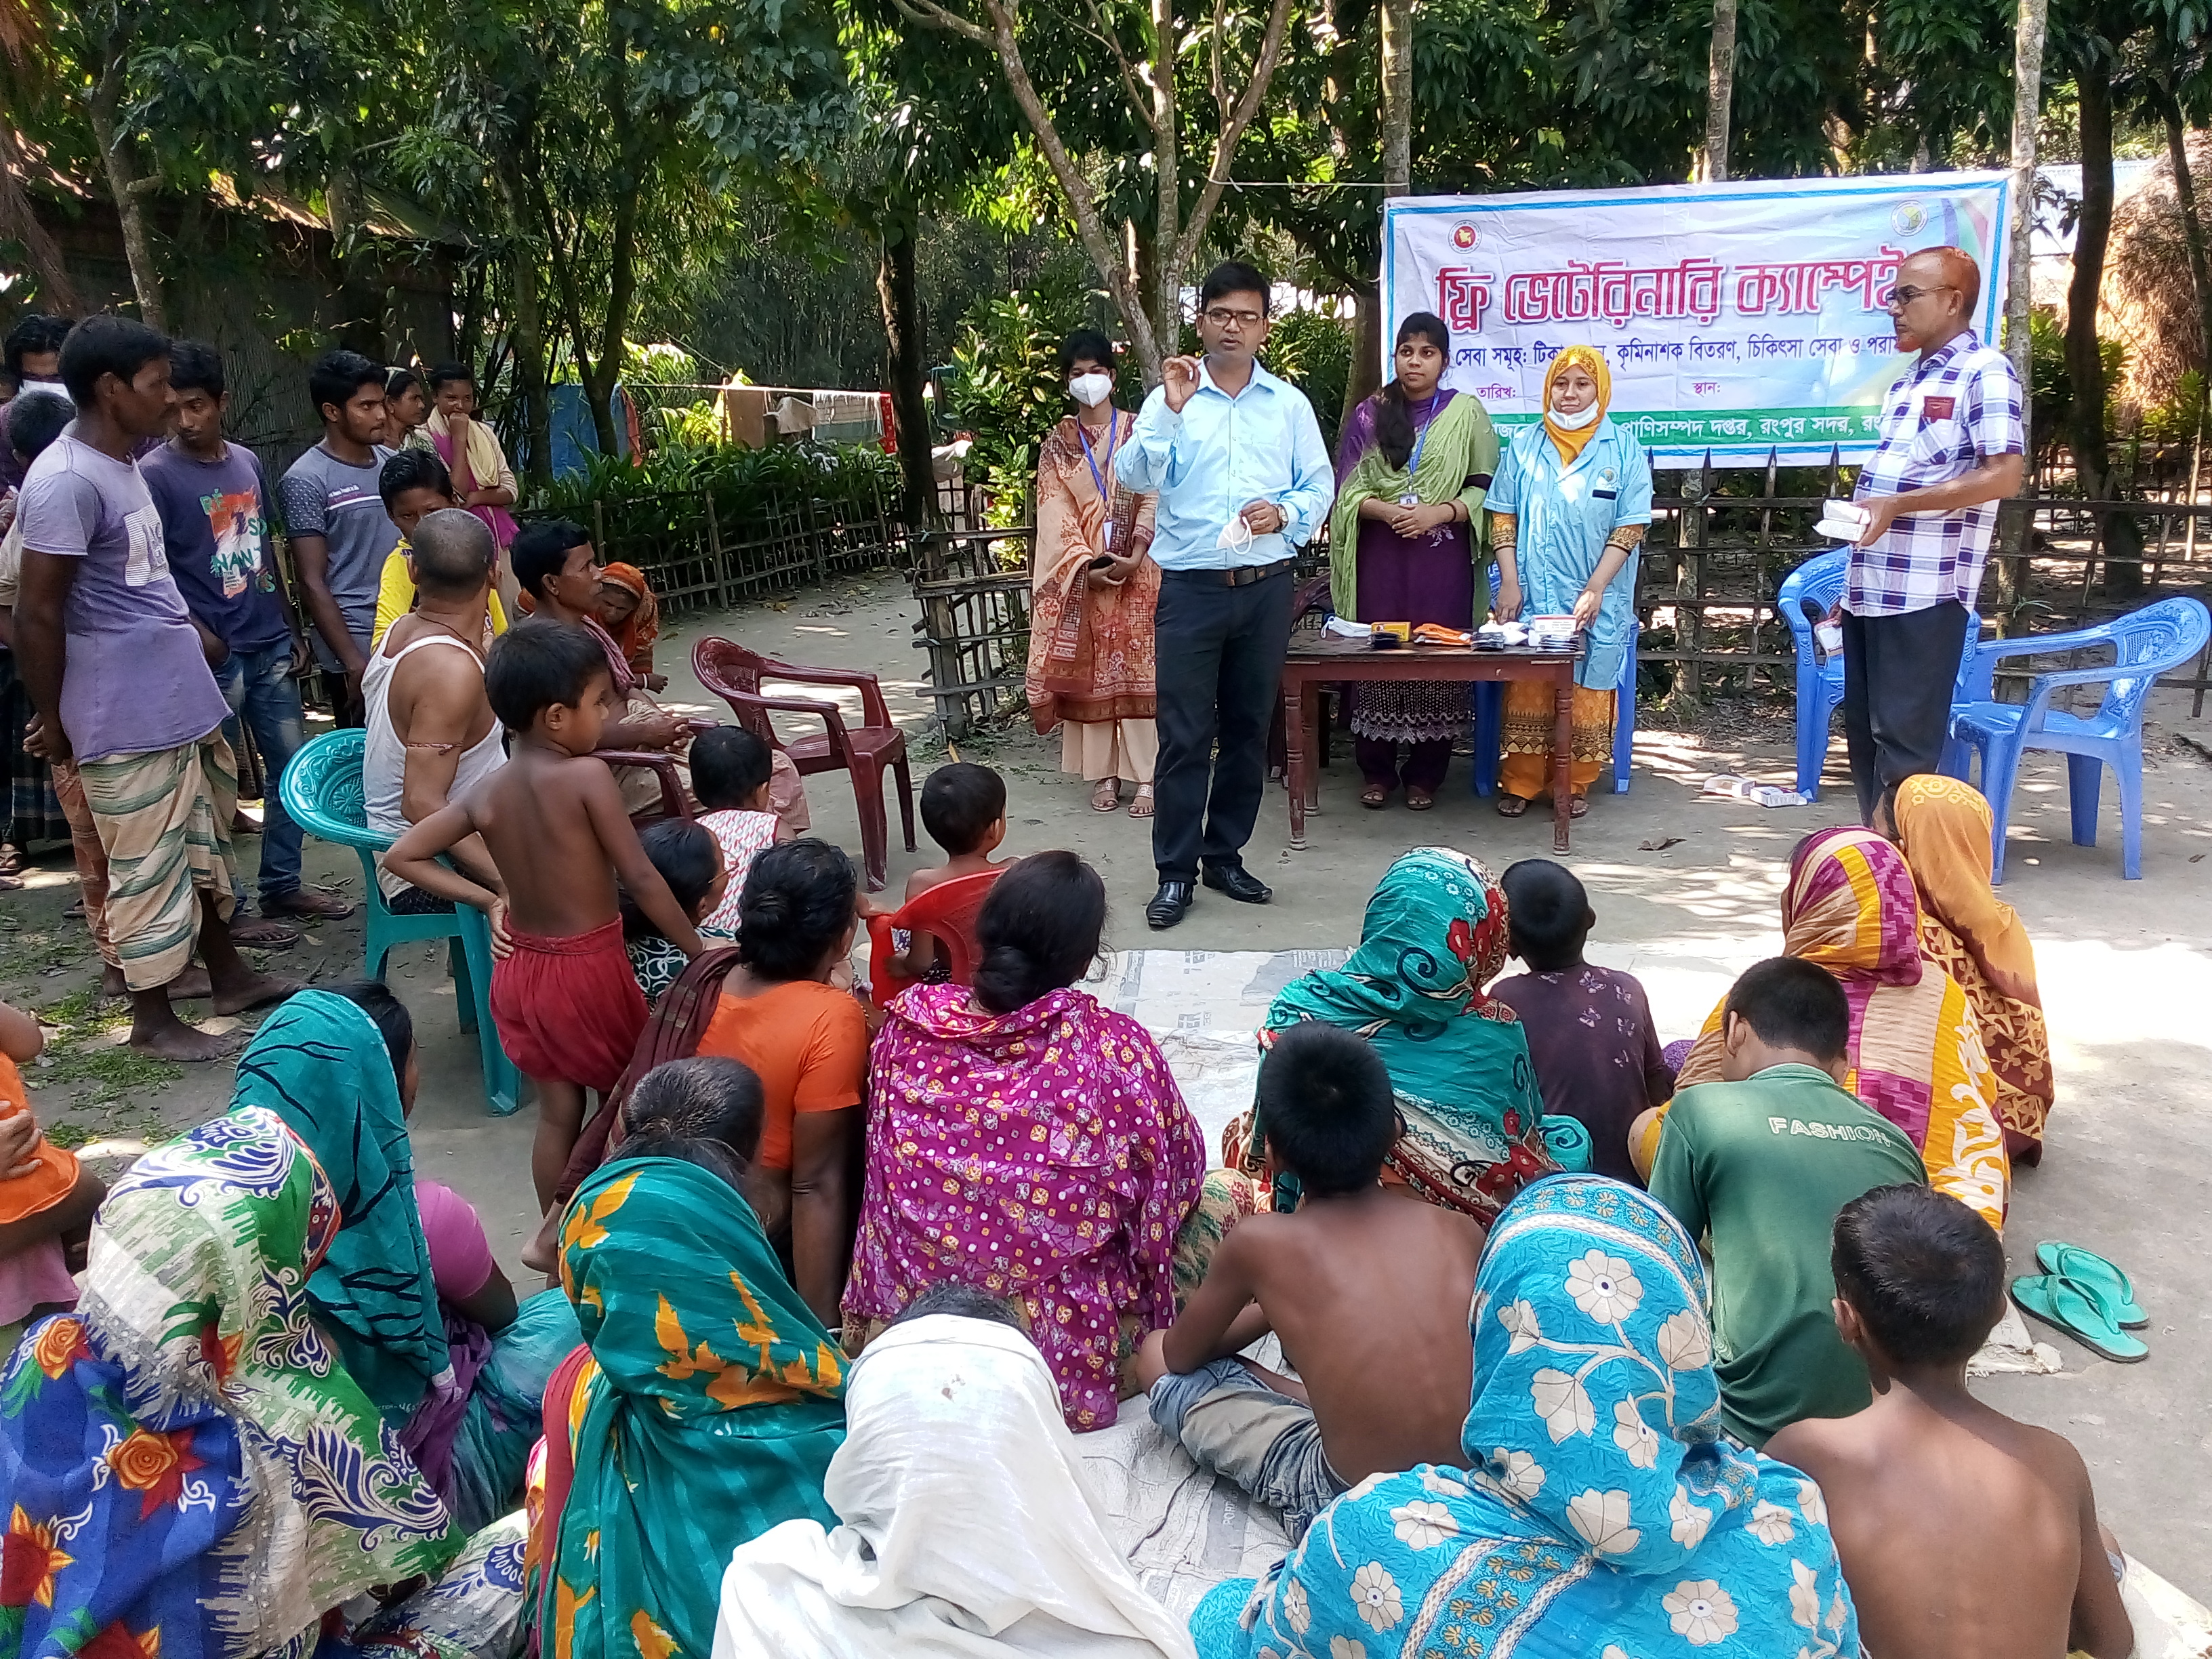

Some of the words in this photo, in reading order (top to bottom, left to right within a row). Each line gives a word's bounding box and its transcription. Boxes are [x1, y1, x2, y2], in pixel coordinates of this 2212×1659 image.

[1435, 266, 1493, 331] ফ্রি
[1504, 258, 1724, 325] ভেটেরিনারি
[1734, 245, 1904, 312] ক্যাম্পেই
[1456, 347, 1487, 367] সেবা
[1492, 346, 1527, 372] সমূহ:
[1616, 337, 1685, 371] কৃমিনাশক
[1688, 335, 1741, 365] বিতরণ,
[1746, 333, 1804, 359] চিকিৎসা
[1809, 337, 1843, 357] সেবা
[1849, 338, 1861, 354] ও
[1476, 383, 1517, 399] তারিখ:
[1692, 382, 1721, 398] স্থান:
[1709, 418, 1753, 439] দপ্তর,
[1759, 416, 1807, 439] রংপুর
[1811, 415, 1855, 436] সদর,
[1767, 1116, 1892, 1148] FASHION
